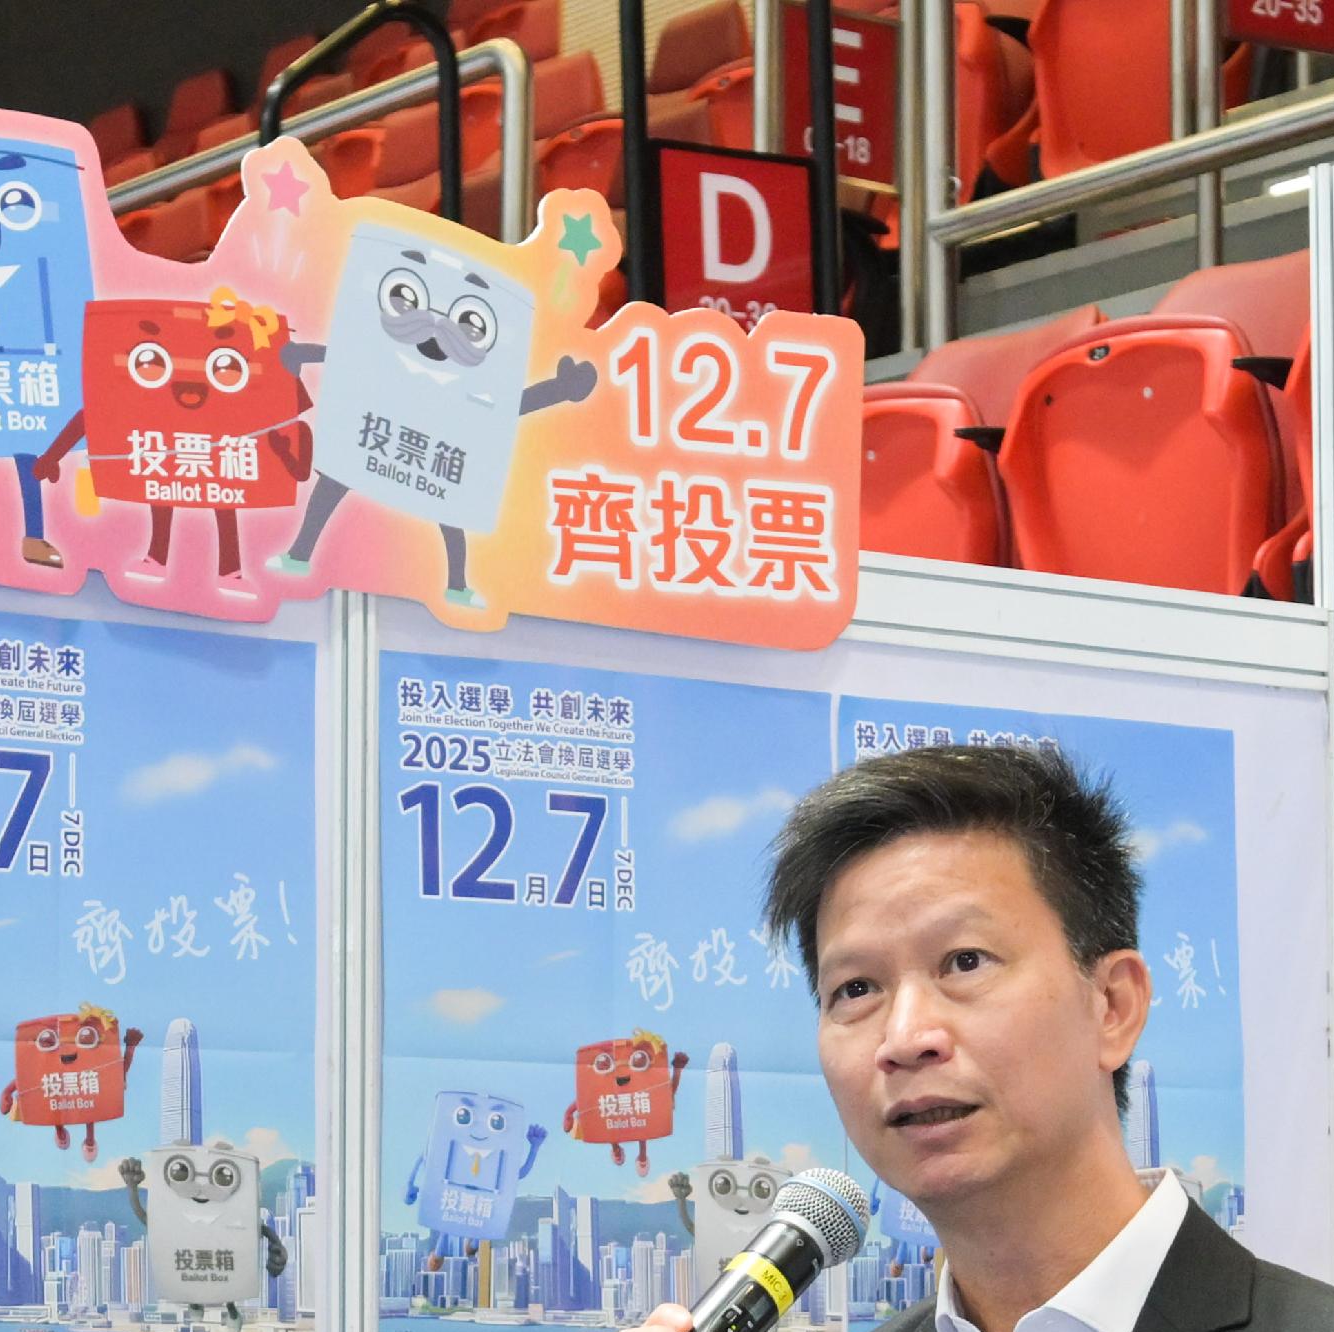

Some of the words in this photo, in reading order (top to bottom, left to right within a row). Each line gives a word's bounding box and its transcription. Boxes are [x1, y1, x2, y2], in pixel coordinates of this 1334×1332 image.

[700, 172, 773, 284] D
[614, 332, 832, 455] 12.7
[7, 411, 47, 431] Box
[127, 429, 258, 482] 投票箱
[357, 411, 465, 484] 投票箱
[145, 480, 202, 504] Ballot
[206, 482, 246, 504] Box
[366, 456, 412, 489] Ballot
[413, 472, 446, 500] Box
[550, 470, 833, 595] 齊投票
[27, 679, 43, 690] the
[47, 681, 82, 692] Future
[400, 679, 511, 715] 投入選舉
[532, 690, 630, 726] 共創未來
[10, 728, 42, 738] General
[45, 731, 81, 741] Election
[401, 712, 422, 723] Join
[425, 715, 441, 725] the
[444, 716, 485, 728] Election
[489, 719, 532, 733] Together
[536, 722, 550, 733] We
[553, 724, 583, 736] Create
[586, 728, 599, 737] the
[602, 730, 631, 740] Future
[495, 768, 538, 778] Legislative
[541, 770, 569, 780] Council
[571, 773, 599, 782] General
[601, 776, 630, 785] Election
[64, 832, 80, 873] DEC
[618, 869, 631, 908] DEC
[73, 873, 296, 984] 齊投票!
[42, 1070, 100, 1098] 投票箱
[49, 1098, 74, 1111] Ballot
[74, 1096, 95, 1110] Box
[598, 1090, 651, 1117] 投票箱
[605, 1117, 627, 1130] Ballot
[628, 1116, 648, 1130] Box
[439, 1187, 494, 1219] 投票箱
[174, 1248, 234, 1273] 投票箱
[180, 1273, 207, 1283] Ballot
[208, 1273, 229, 1283] Box
[762, 1269, 782, 1292] MIC
